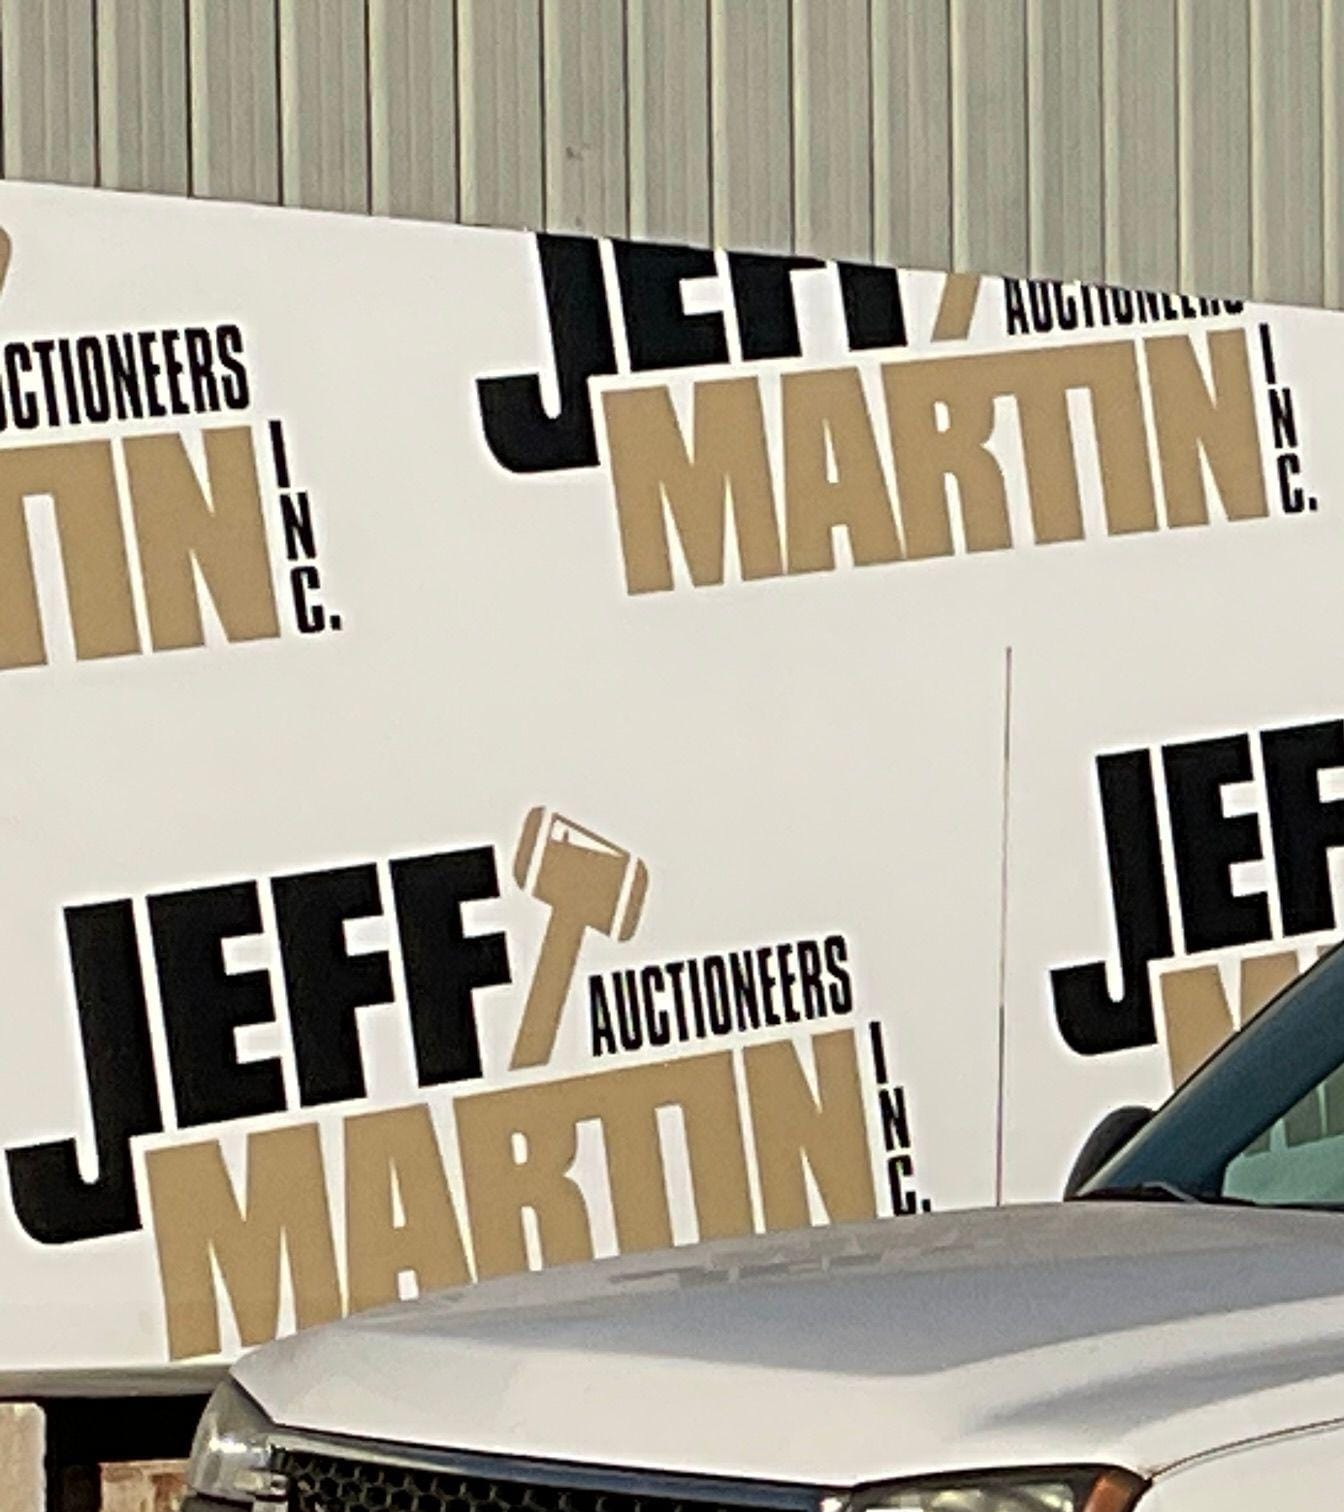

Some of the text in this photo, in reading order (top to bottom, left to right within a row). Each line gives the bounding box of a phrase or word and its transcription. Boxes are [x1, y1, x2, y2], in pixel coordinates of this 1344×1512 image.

[0, 324, 251, 433] CTIONEERS
[602, 328, 1270, 597] MARTIN
[5, 845, 511, 1245] JEFF
[589, 935, 854, 1057] AUCTIONEERS
[145, 1028, 878, 1362] MARTIN
